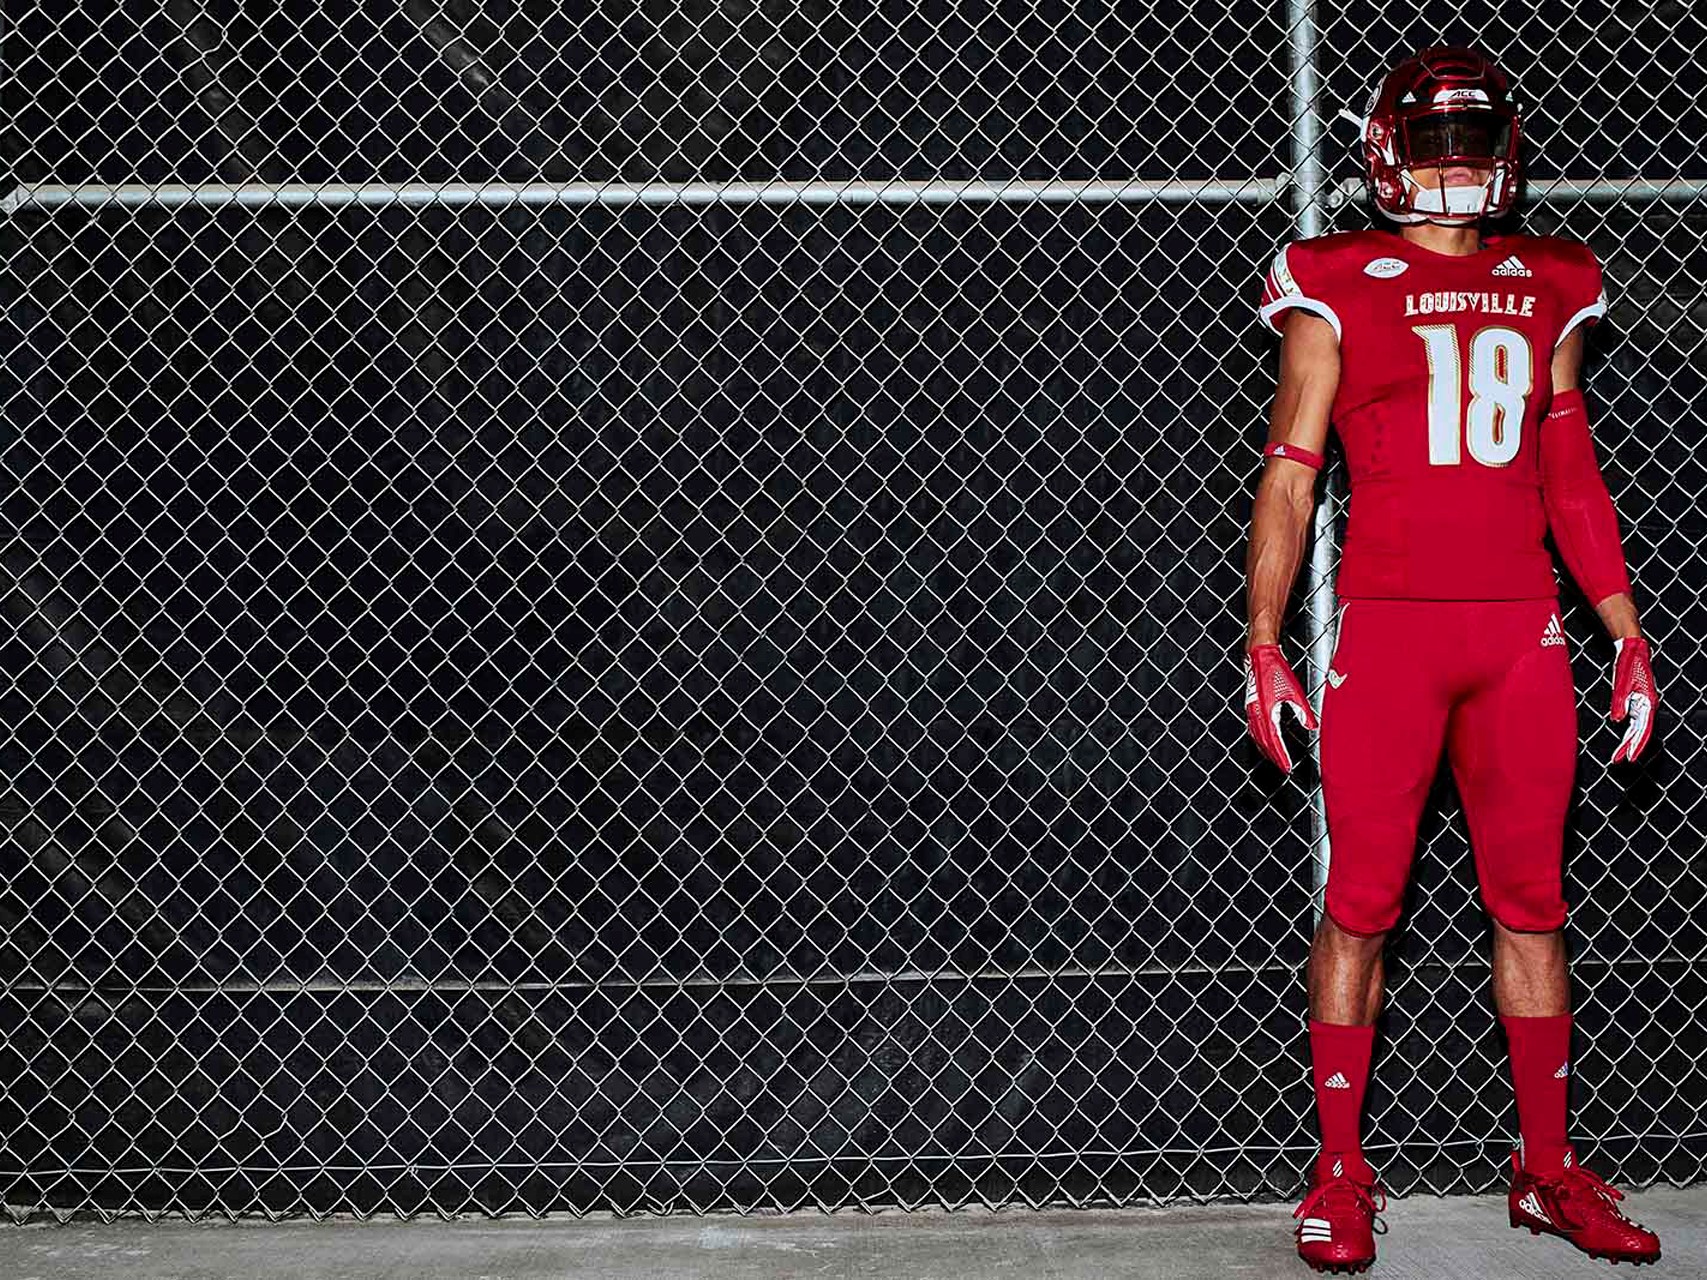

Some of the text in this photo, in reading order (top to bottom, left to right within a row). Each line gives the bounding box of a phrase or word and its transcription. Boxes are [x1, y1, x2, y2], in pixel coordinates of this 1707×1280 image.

[1450, 90, 1476, 98] ACC
[1491, 267, 1533, 278] adidas
[1404, 291, 1537, 318] LOUISVILLE
[1411, 323, 1534, 468] 18
